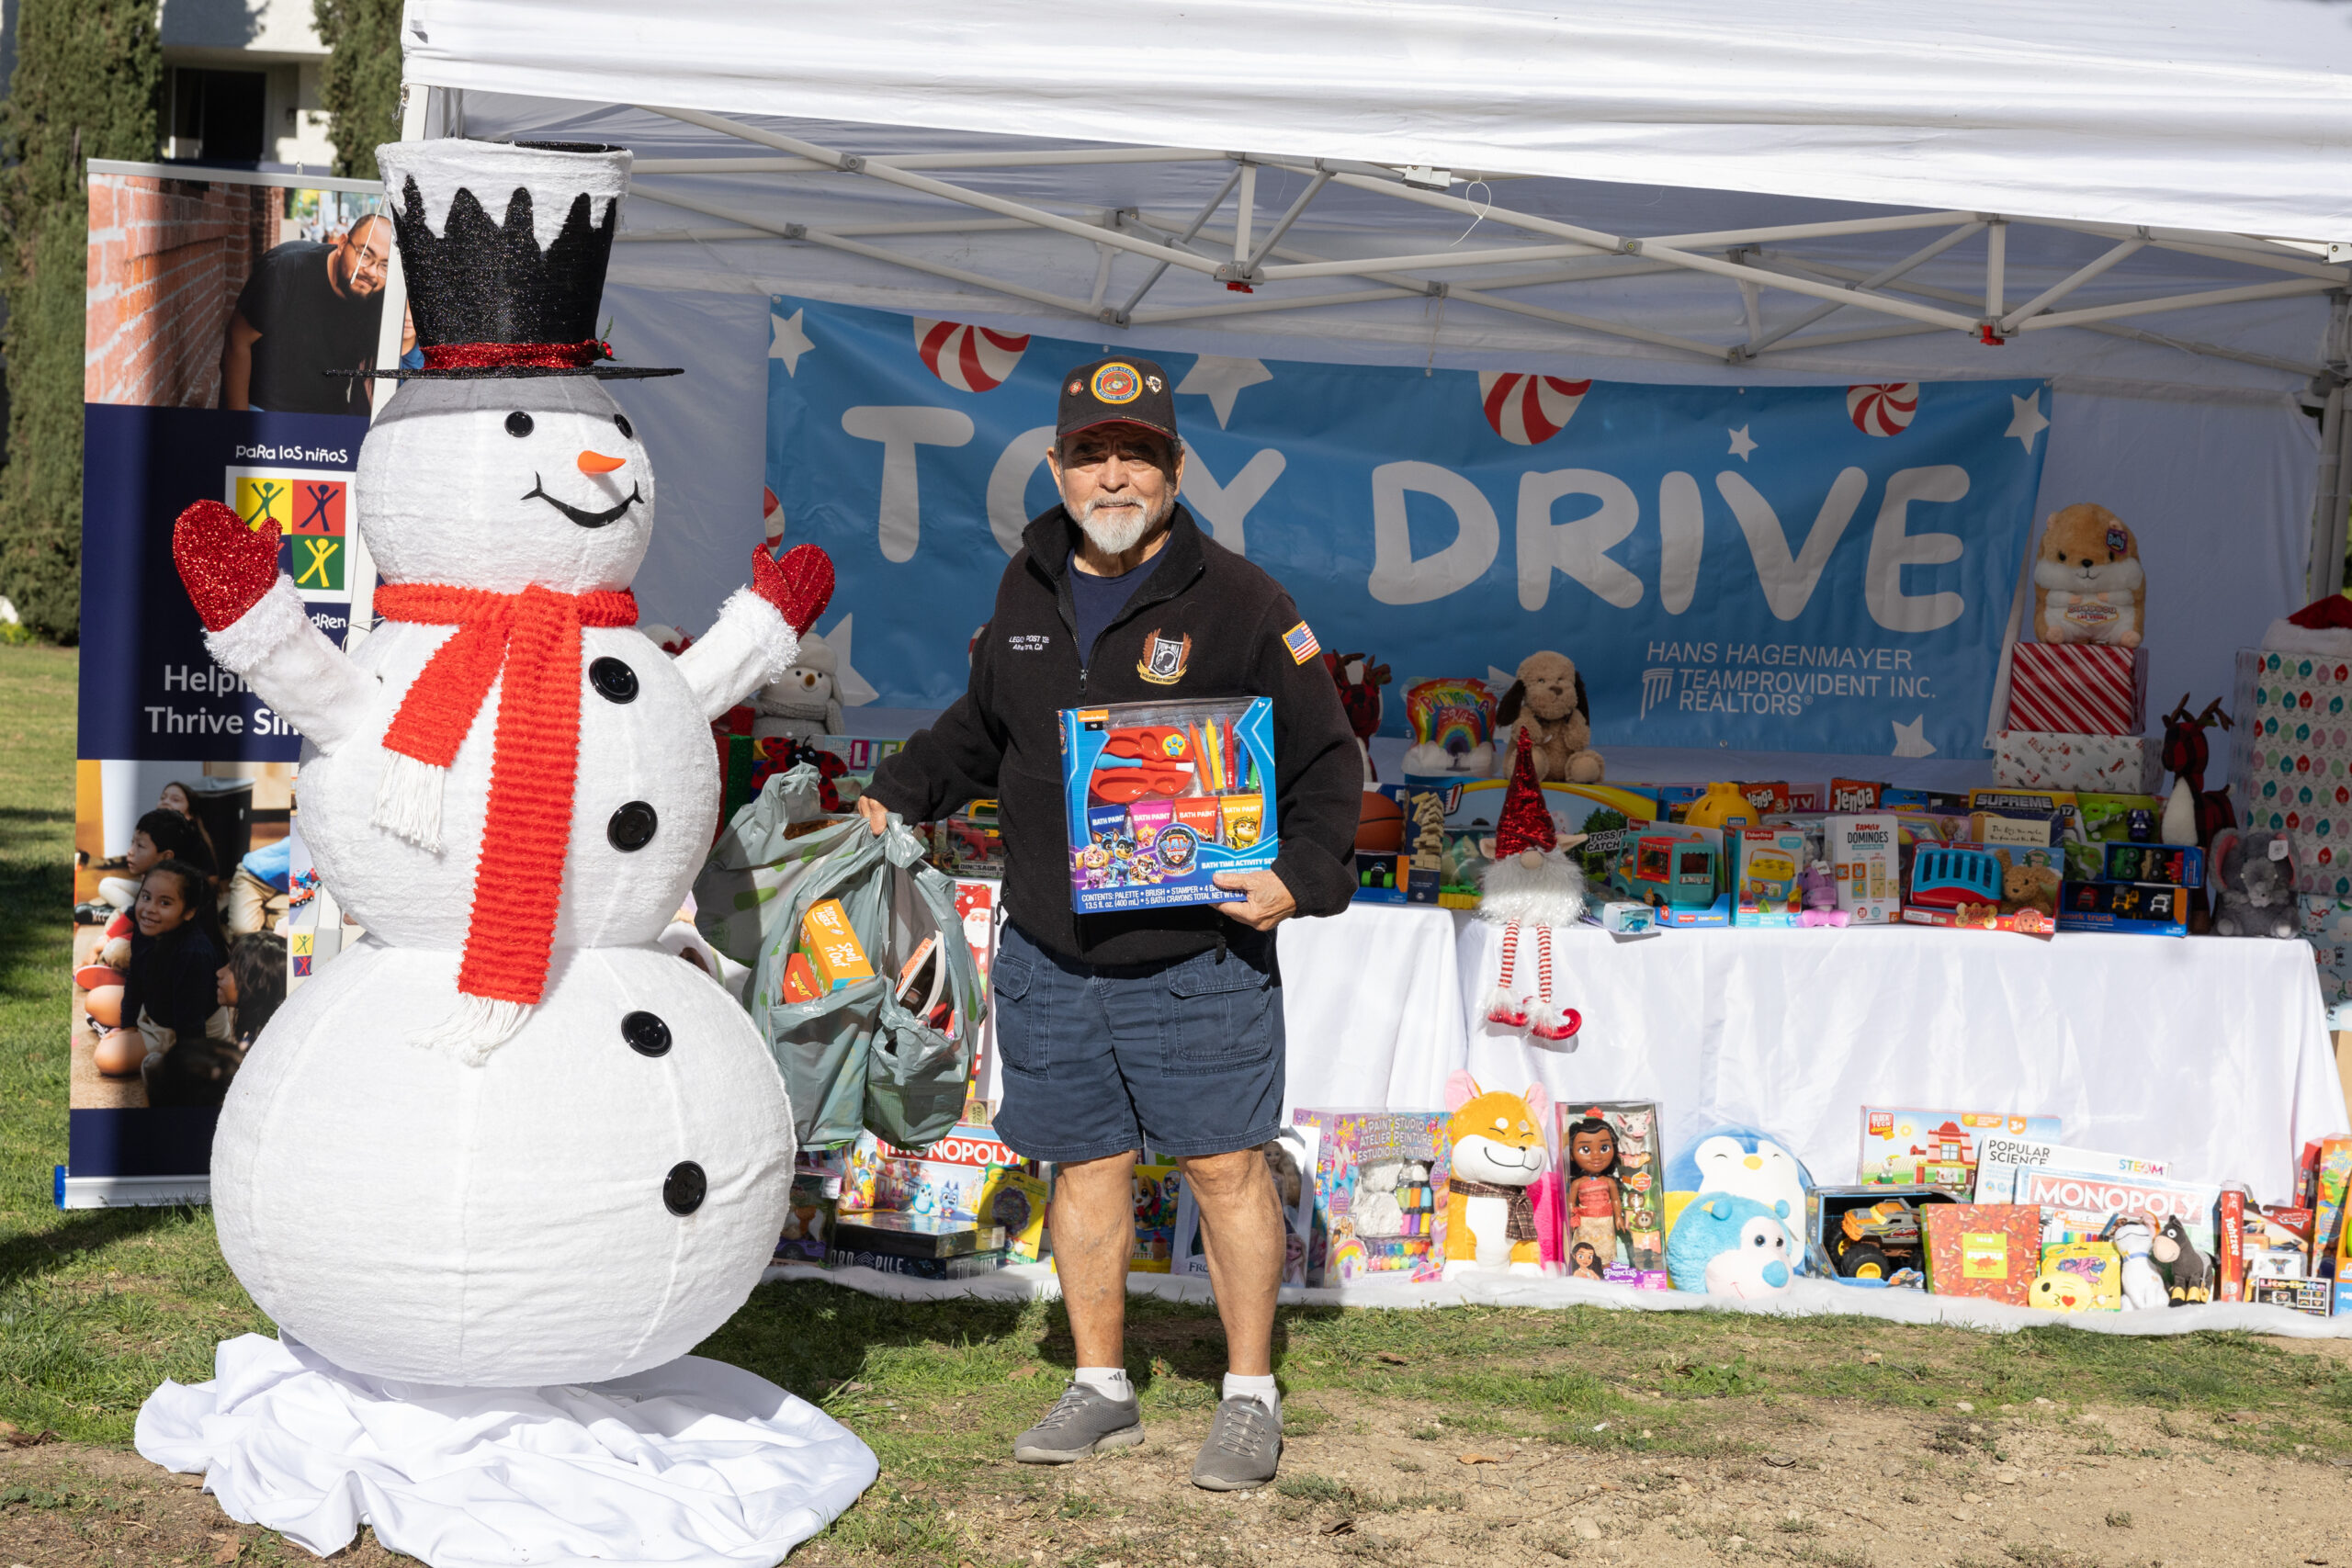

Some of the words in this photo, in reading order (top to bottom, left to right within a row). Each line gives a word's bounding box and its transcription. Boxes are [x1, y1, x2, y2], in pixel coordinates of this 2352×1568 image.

[1099, 367, 1119, 378] UNITED
[1120, 367, 1136, 380] STATES
[1098, 389, 1116, 400] MARINE
[1119, 389, 1135, 400] CORPS
[1368, 460, 1970, 634] DRIVE
[1646, 641, 1718, 663] HANS
[1725, 644, 1913, 671] HAGENMAYER
[1679, 669, 1883, 697] TEAMPROVIDENT
[1890, 676, 1936, 699] INC.
[144, 705, 243, 734] Thrive
[1746, 788, 1774, 808] Jenga
[1834, 787, 1874, 811] Jenga
[1976, 793, 2053, 808] SUPREME
[1133, 814, 1151, 822] BATH
[1154, 812, 1170, 820] PAINT
[1240, 805, 1261, 813] PAINT
[2061, 806, 2075, 816] 17
[1108, 815, 1125, 824] PAINT
[1856, 823, 1880, 831] FAMILY
[1589, 829, 1616, 843] TOSS
[1618, 829, 1627, 840] IT
[1848, 831, 1889, 844] DOMINOES
[1160, 837, 1193, 853] PAW
[1587, 840, 1621, 853] CATCH
[1235, 858, 1262, 867] ACTIVITY
[1264, 857, 1276, 865] SET
[1081, 892, 1114, 903] CONTENTS:
[1114, 889, 1139, 899] PALETTE
[1145, 887, 1166, 897] BRUSH
[1170, 886, 1198, 896] STAMPER
[1204, 885, 1209, 893] 4
[1084, 901, 1096, 909] 13.5
[1114, 898, 1128, 908] (400
[1145, 897, 1149, 905] 5
[1149, 895, 1164, 904] BATH
[1164, 893, 1193, 903] CRAYONS
[1193, 892, 1211, 901] TOTAL
[1211, 891, 1223, 900] NET
[2087, 913, 2113, 922] truck
[828, 952, 851, 968] Out
[836, 942, 864, 963] Spell
[1367, 1118, 1391, 1133] PAINT
[1395, 1116, 1425, 1132] STUDIO
[2010, 1120, 2024, 1131] 3+
[1360, 1132, 1391, 1148] ATELIER
[1393, 1131, 1433, 1146] PEINTURE
[1988, 1139, 2051, 1157] POPULAR
[1357, 1145, 1391, 1163] ESTUDIO
[1392, 1147, 1400, 1156] DE
[1400, 1145, 1435, 1162] PINTURA
[2119, 1158, 2165, 1176] STEAM
[2034, 1179, 2199, 1221] MONOPOLY
[2224, 1216, 2240, 1257] Yahtzee
[875, 1255, 904, 1275] PILE
